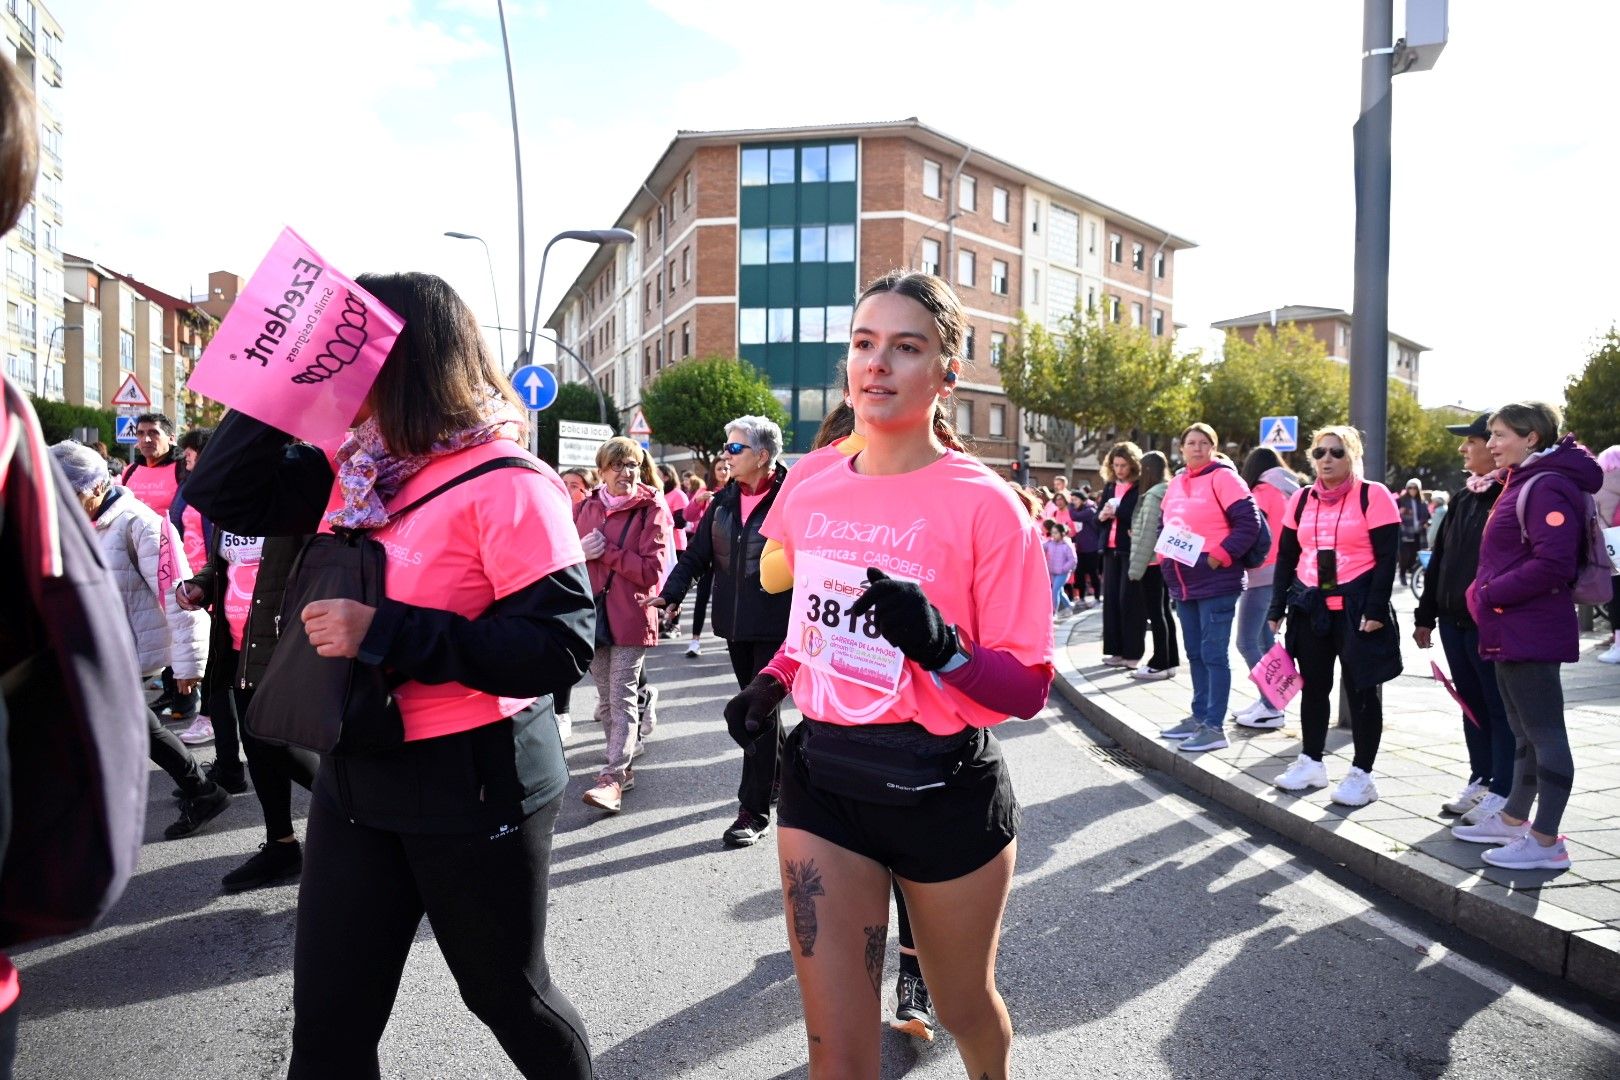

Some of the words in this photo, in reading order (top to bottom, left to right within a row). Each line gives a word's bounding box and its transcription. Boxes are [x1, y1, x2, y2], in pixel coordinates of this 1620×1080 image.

[1167, 536, 1193, 552] 2821
[863, 551, 936, 583] CAROBELS
[823, 579, 833, 590] el
[834, 580, 866, 597] bierz
[806, 594, 881, 639] 3818
[831, 634, 858, 647] CARRERA
[858, 641, 866, 649] DE
[875, 646, 897, 659] MUJER
